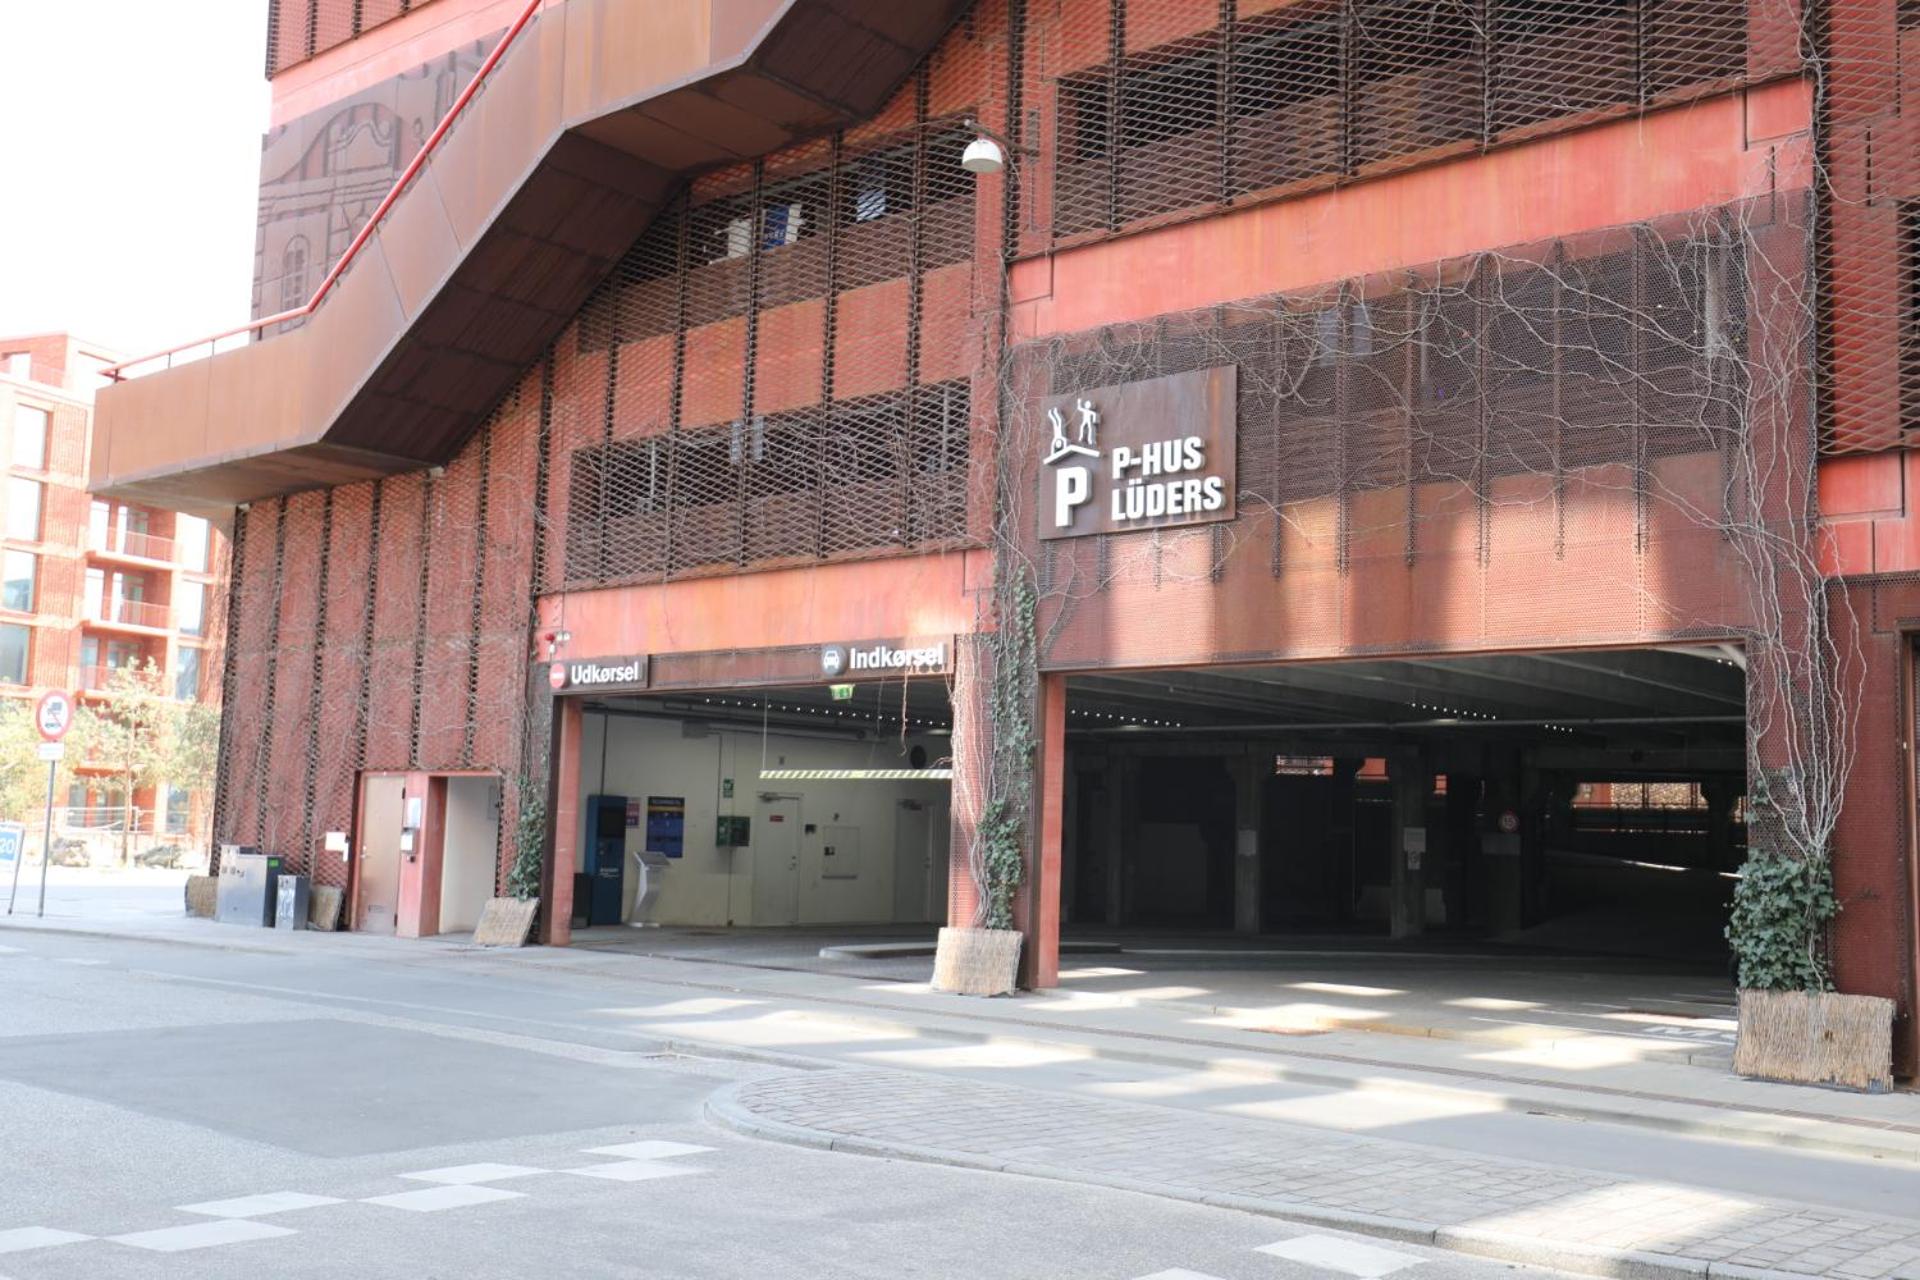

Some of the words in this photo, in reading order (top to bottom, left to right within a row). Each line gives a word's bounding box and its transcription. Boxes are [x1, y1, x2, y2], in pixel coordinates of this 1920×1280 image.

[1112, 436, 1203, 480] P-HUS
[1055, 466, 1089, 527] P
[1111, 476, 1223, 521] LÜDERS
[571, 661, 639, 685] Udkørsel
[850, 642, 944, 669] Indkørsel
